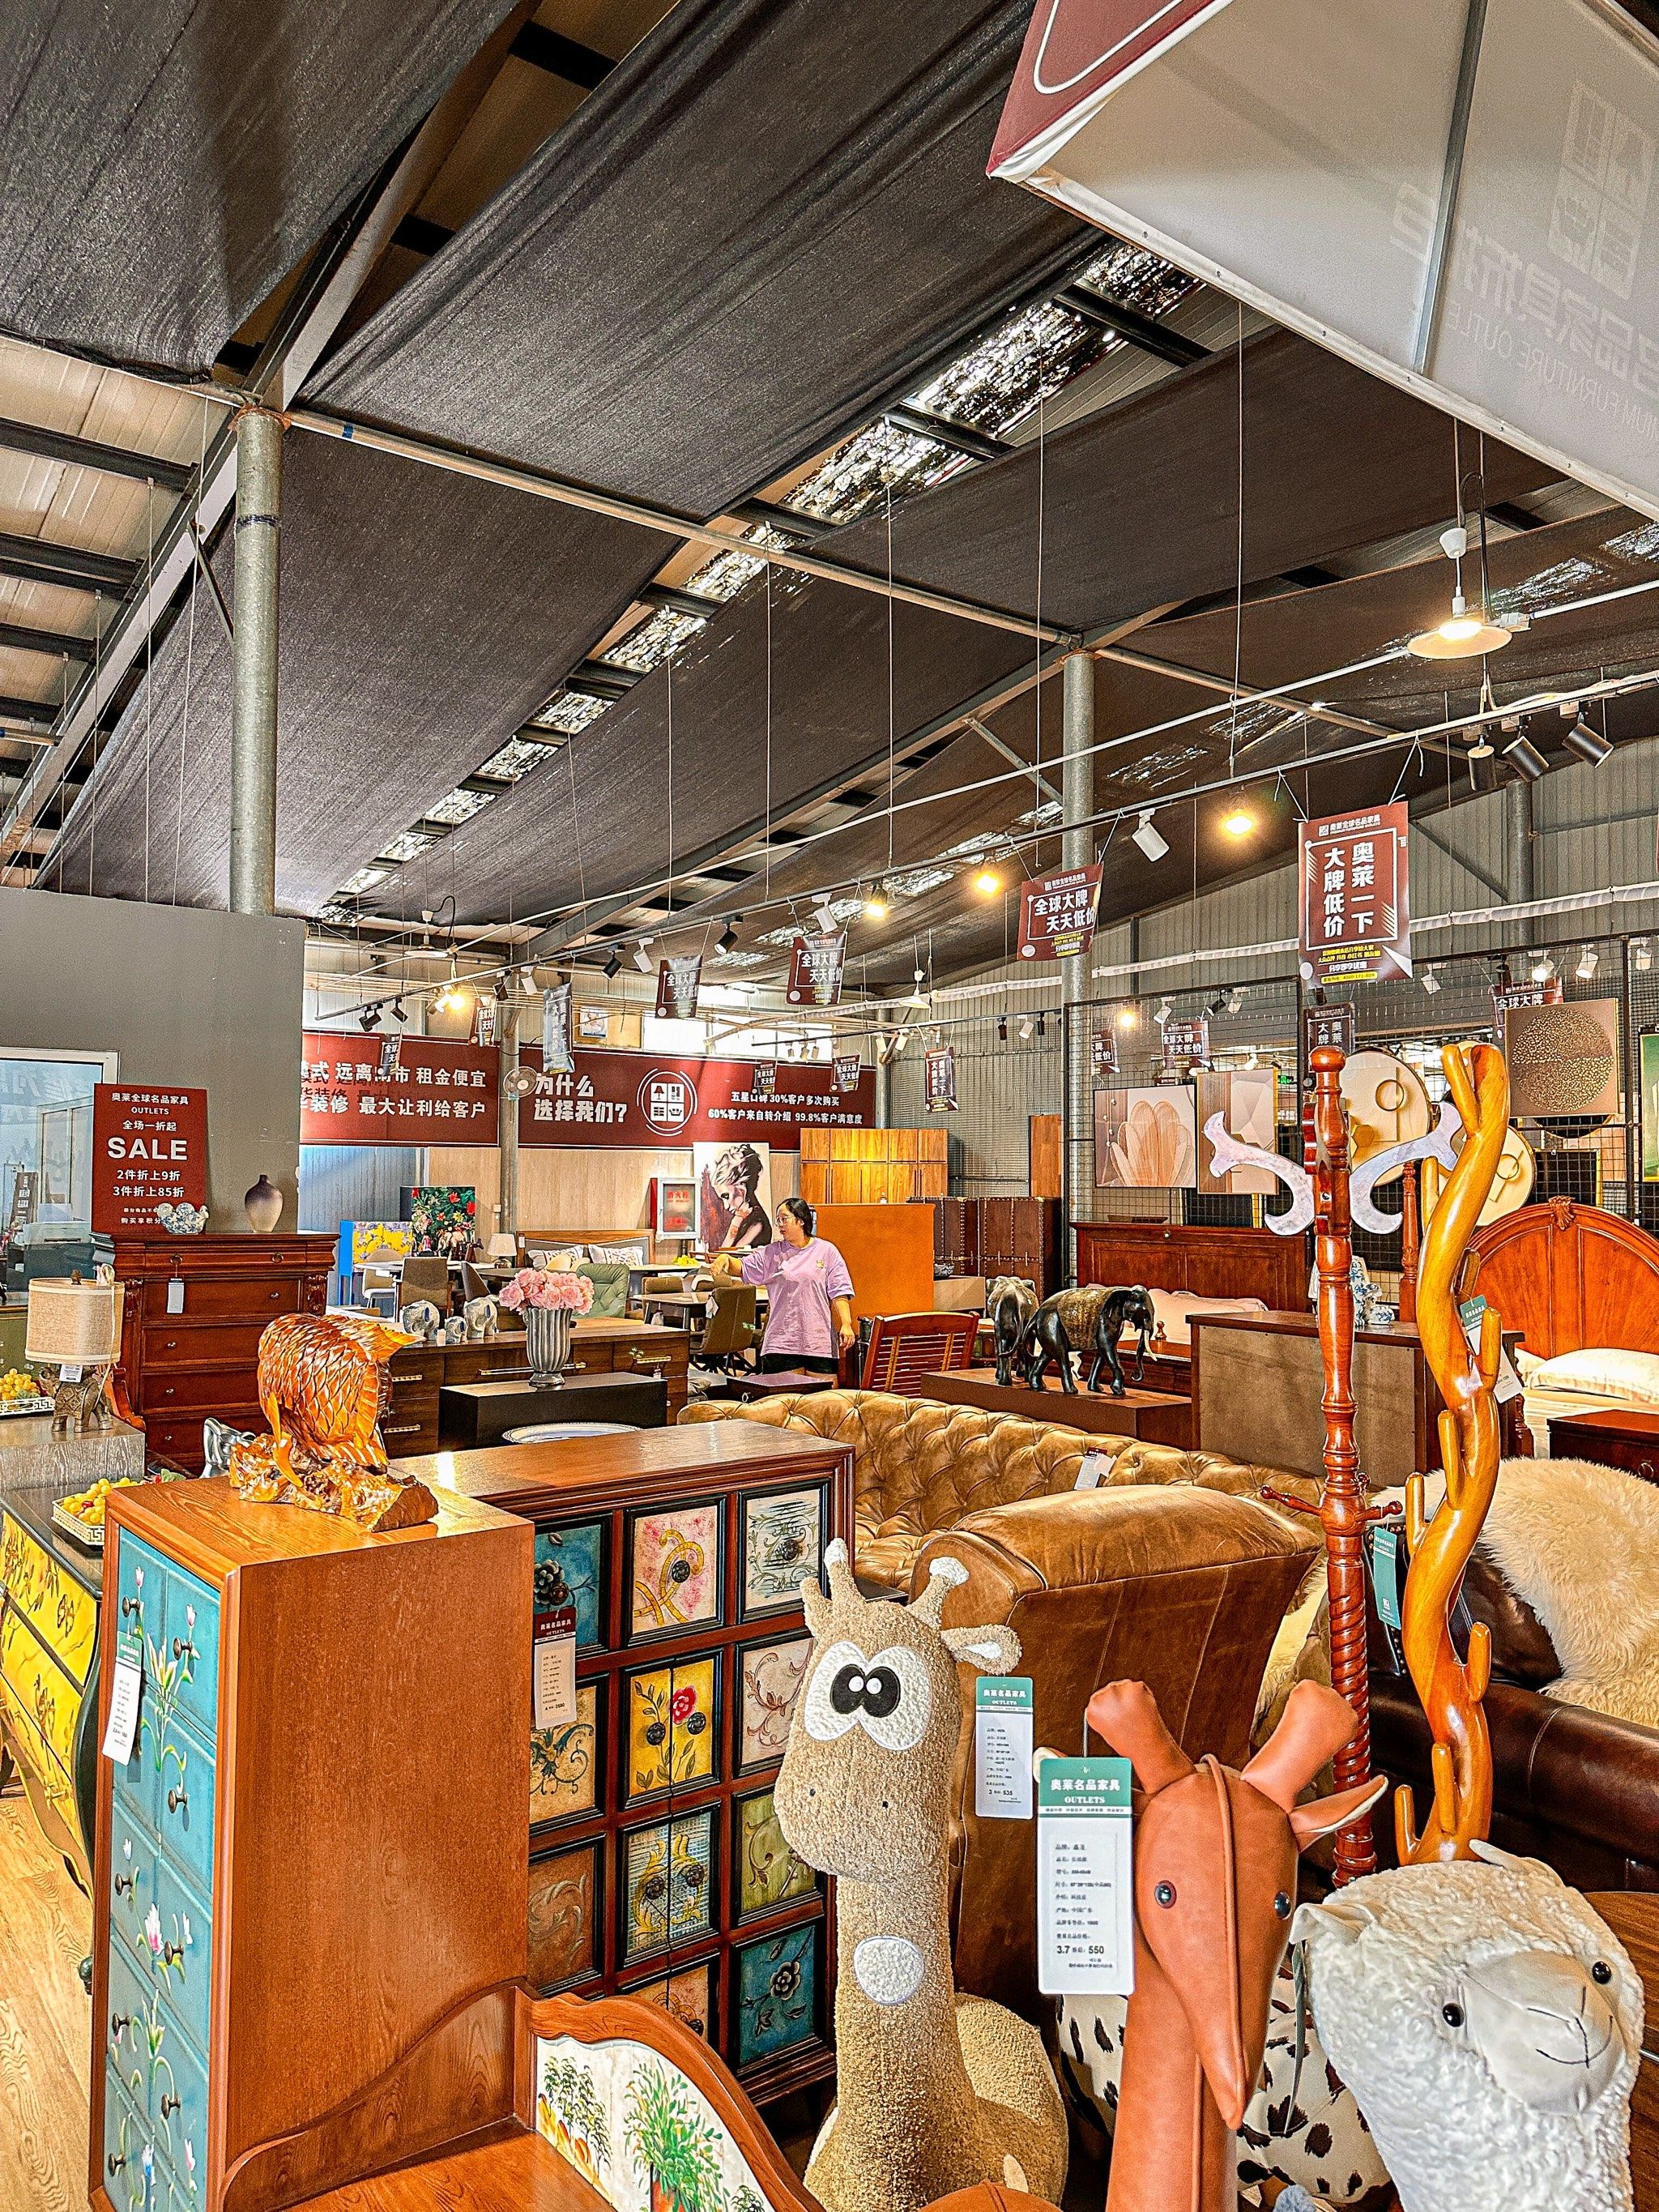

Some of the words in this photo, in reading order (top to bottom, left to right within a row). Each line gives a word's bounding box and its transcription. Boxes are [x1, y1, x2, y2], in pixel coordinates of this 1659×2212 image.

[1324, 847, 1346, 938] 大牌低价
[1351, 841, 1375, 934] 奥莱一下
[1034, 889, 1089, 916] 全球大牌
[1046, 906, 1095, 933] 天天低价
[800, 951, 839, 968] 全球大牌
[667, 971, 697, 987] 全球大牌
[1497, 993, 1544, 1010] 全球大牌
[416, 1067, 486, 1087] 租金便宜
[535, 1073, 594, 1097] 为什么
[112, 1092, 189, 1105] 奥莱全球名品家具
[359, 1096, 486, 1118] 最大让利给客户
[770, 1094, 840, 1107] 30%客户多次购买
[131, 1107, 169, 1115] OUTLETS
[534, 1099, 628, 1123] 选择我们?
[708, 1108, 791, 1122] 60%客户来自转介绍
[795, 1112, 863, 1125] 99.8%客户满意度
[122, 1120, 177, 1132] 全场一折起
[108, 1137, 188, 1160] SALE
[117, 1169, 181, 1181] 2件折上9折
[113, 1186, 185, 1198] 3件折上85折
[1051, 1779, 1120, 1791] 奥莱名品家具
[1064, 1796, 1106, 1804] OUTLETS
[1056, 1945, 1070, 1954] 3.7
[1088, 1945, 1104, 1954] 550
